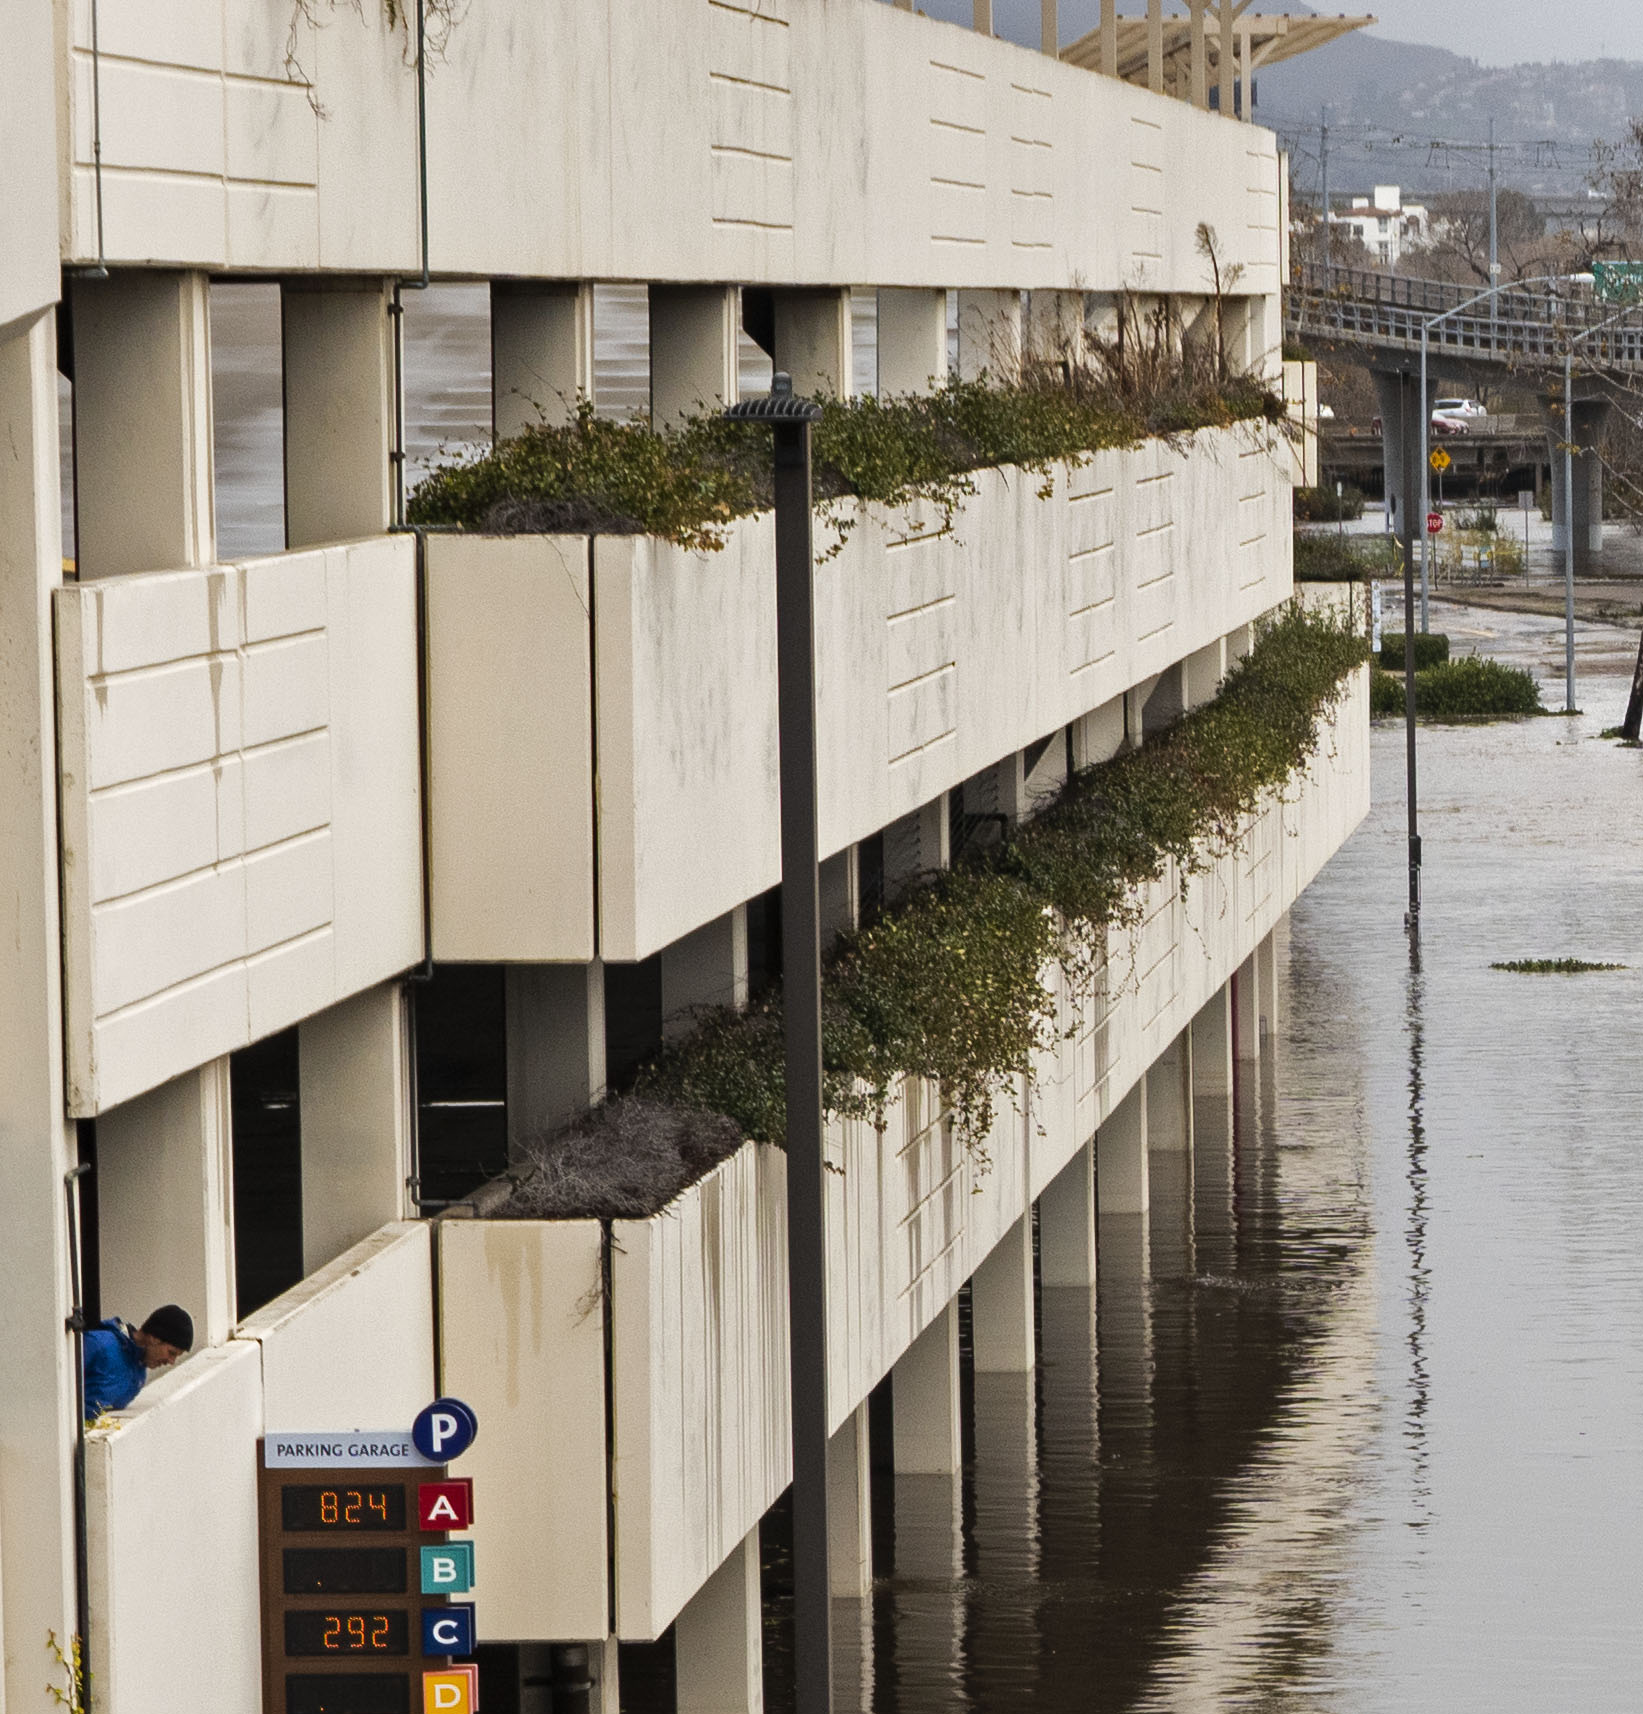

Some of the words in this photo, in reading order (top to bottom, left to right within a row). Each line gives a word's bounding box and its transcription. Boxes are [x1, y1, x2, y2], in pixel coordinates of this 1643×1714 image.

[431, 1413, 458, 1453] P
[277, 1444, 343, 1457] PARKING
[348, 1444, 409, 1457] GARAGE
[320, 1491, 387, 1523] 824
[427, 1495, 458, 1521] A
[432, 1557, 457, 1584] B
[323, 1616, 389, 1648] 292
[432, 1619, 459, 1645] C
[434, 1683, 461, 1709] D
